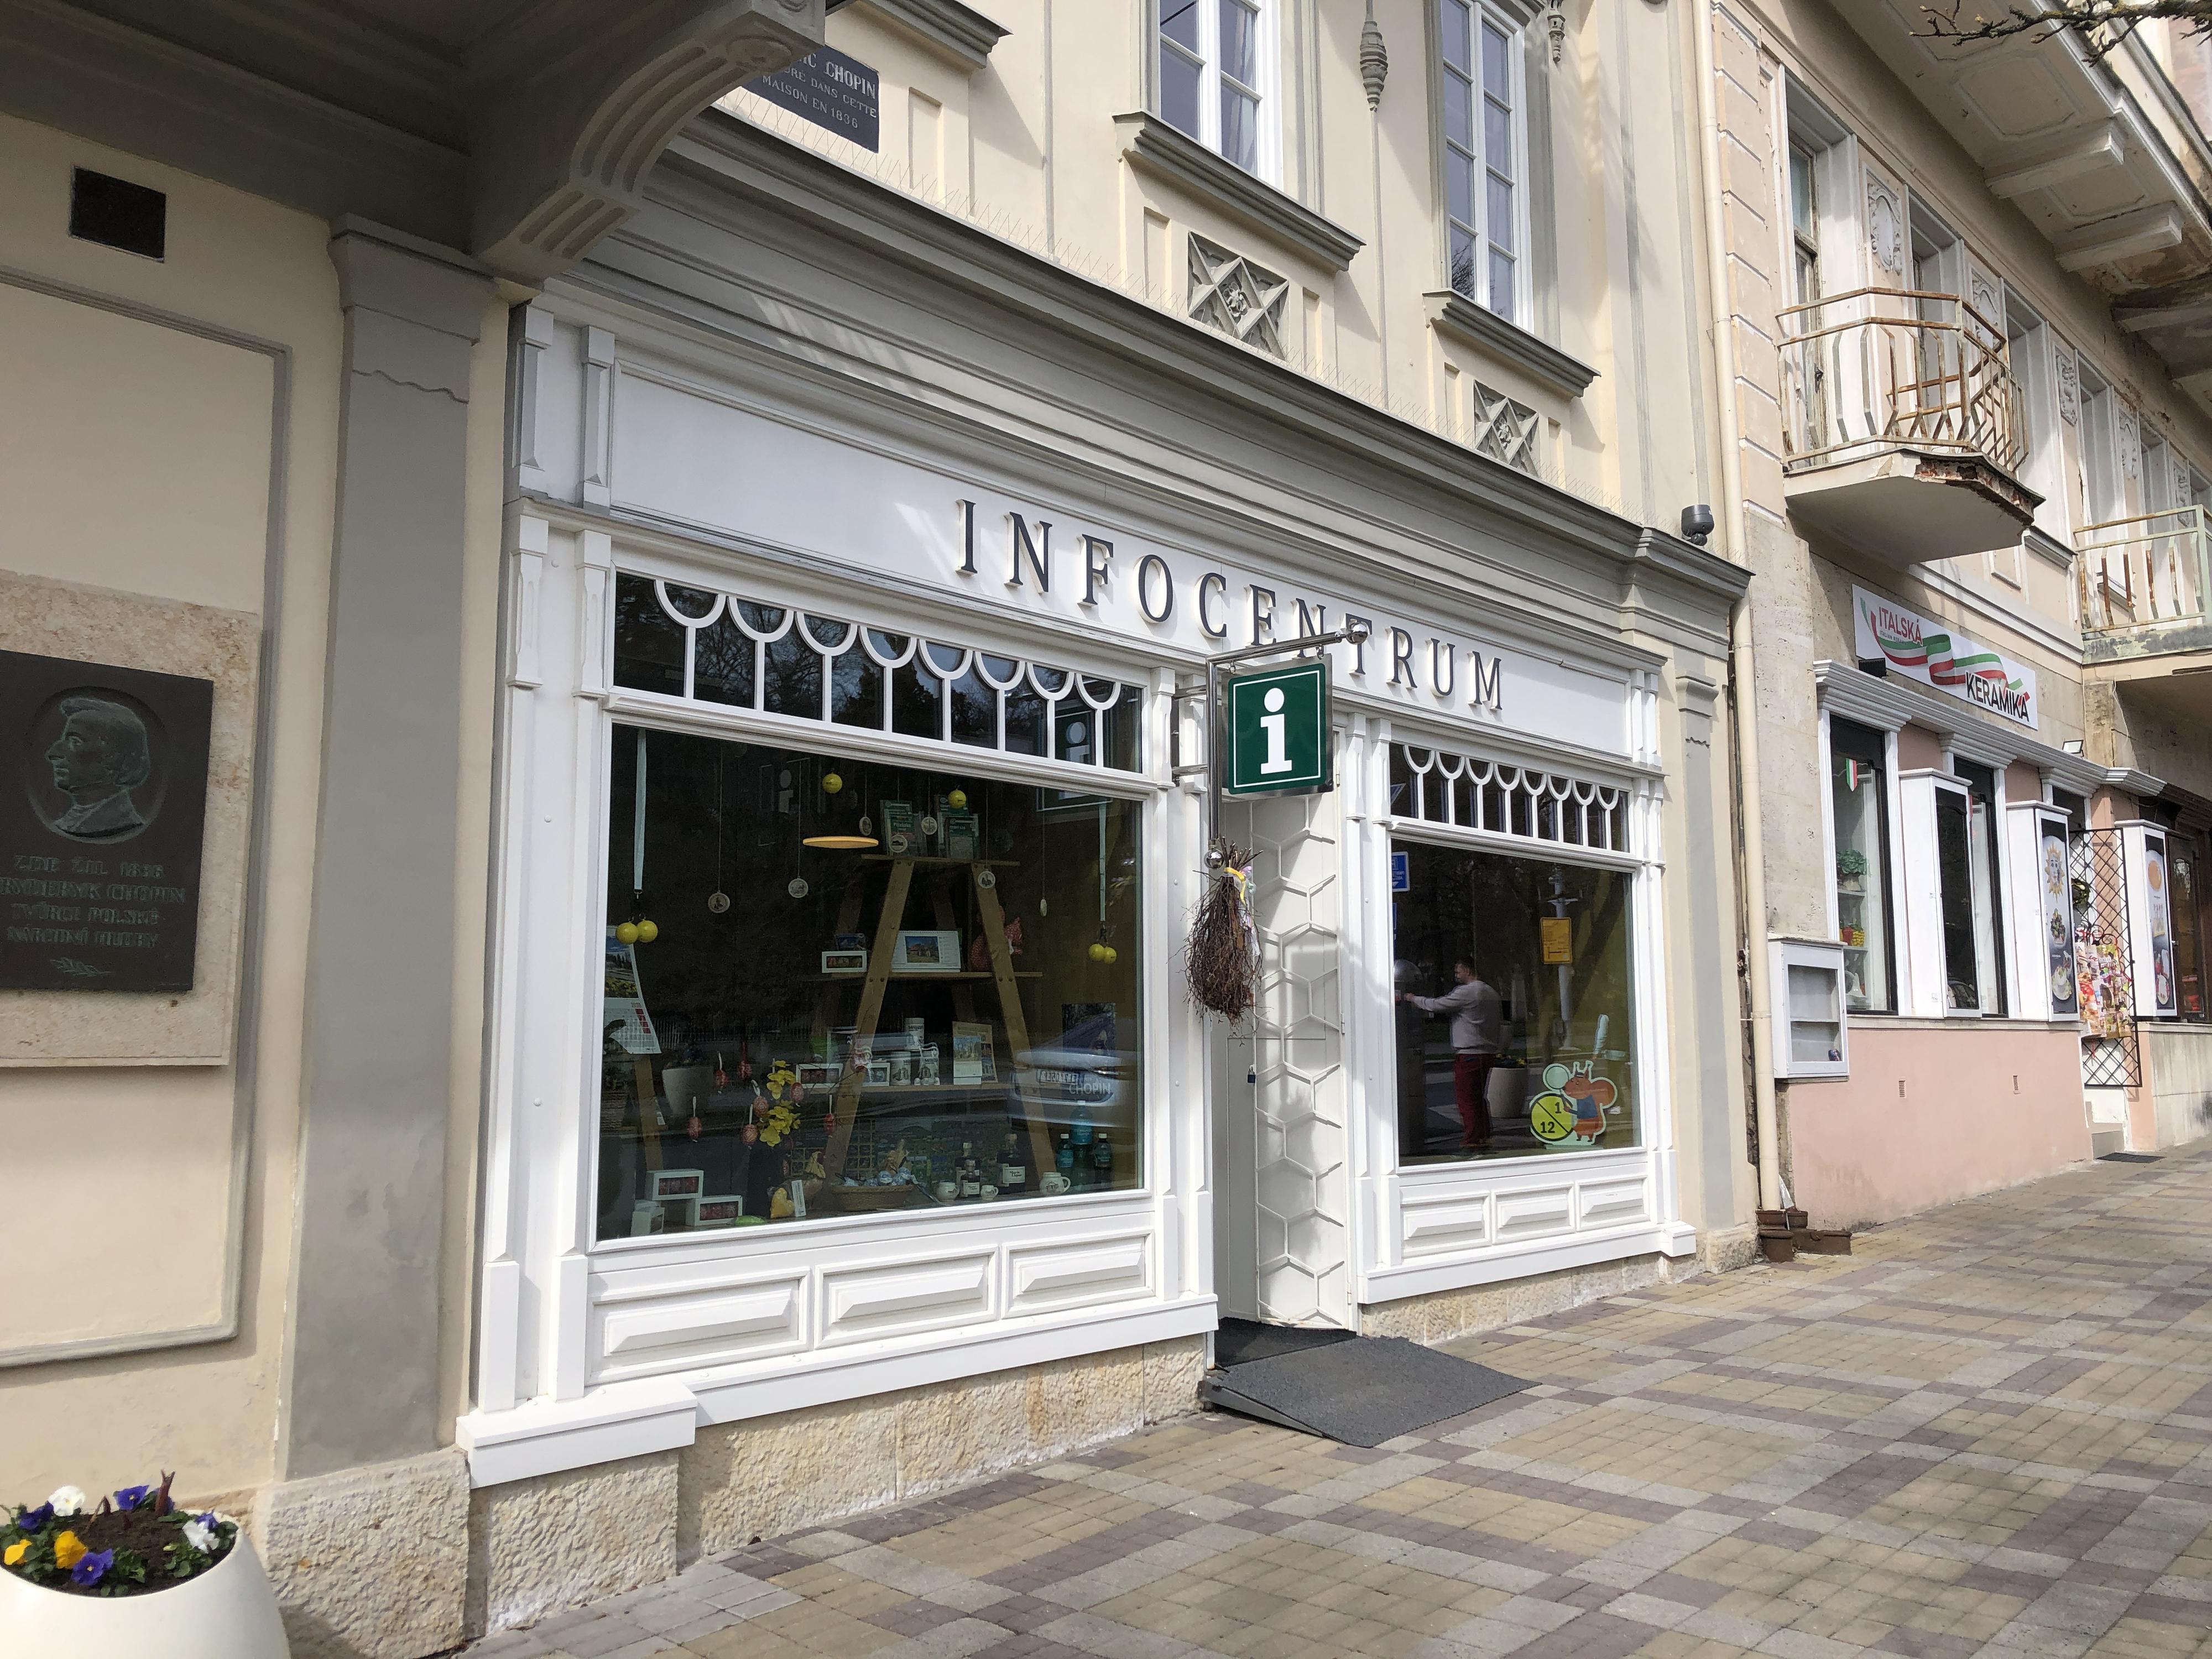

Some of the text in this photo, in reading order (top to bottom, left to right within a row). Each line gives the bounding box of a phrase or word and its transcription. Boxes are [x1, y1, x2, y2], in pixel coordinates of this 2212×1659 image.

[811, 77, 838, 98] DANS
[843, 95, 877, 118] CETTE
[824, 62, 876, 100] CHOPIN
[763, 75, 858, 128] MAISON EN 1836
[958, 499, 1503, 712] INFOCENTRUM
[1879, 606, 1923, 646] ITALSKÁ
[1965, 672, 2030, 722] KERAMIKA
[107, 884, 186, 903] CHOPIN
[1540, 1121, 1555, 1133] 12
[1554, 1102, 1562, 1114] 1
